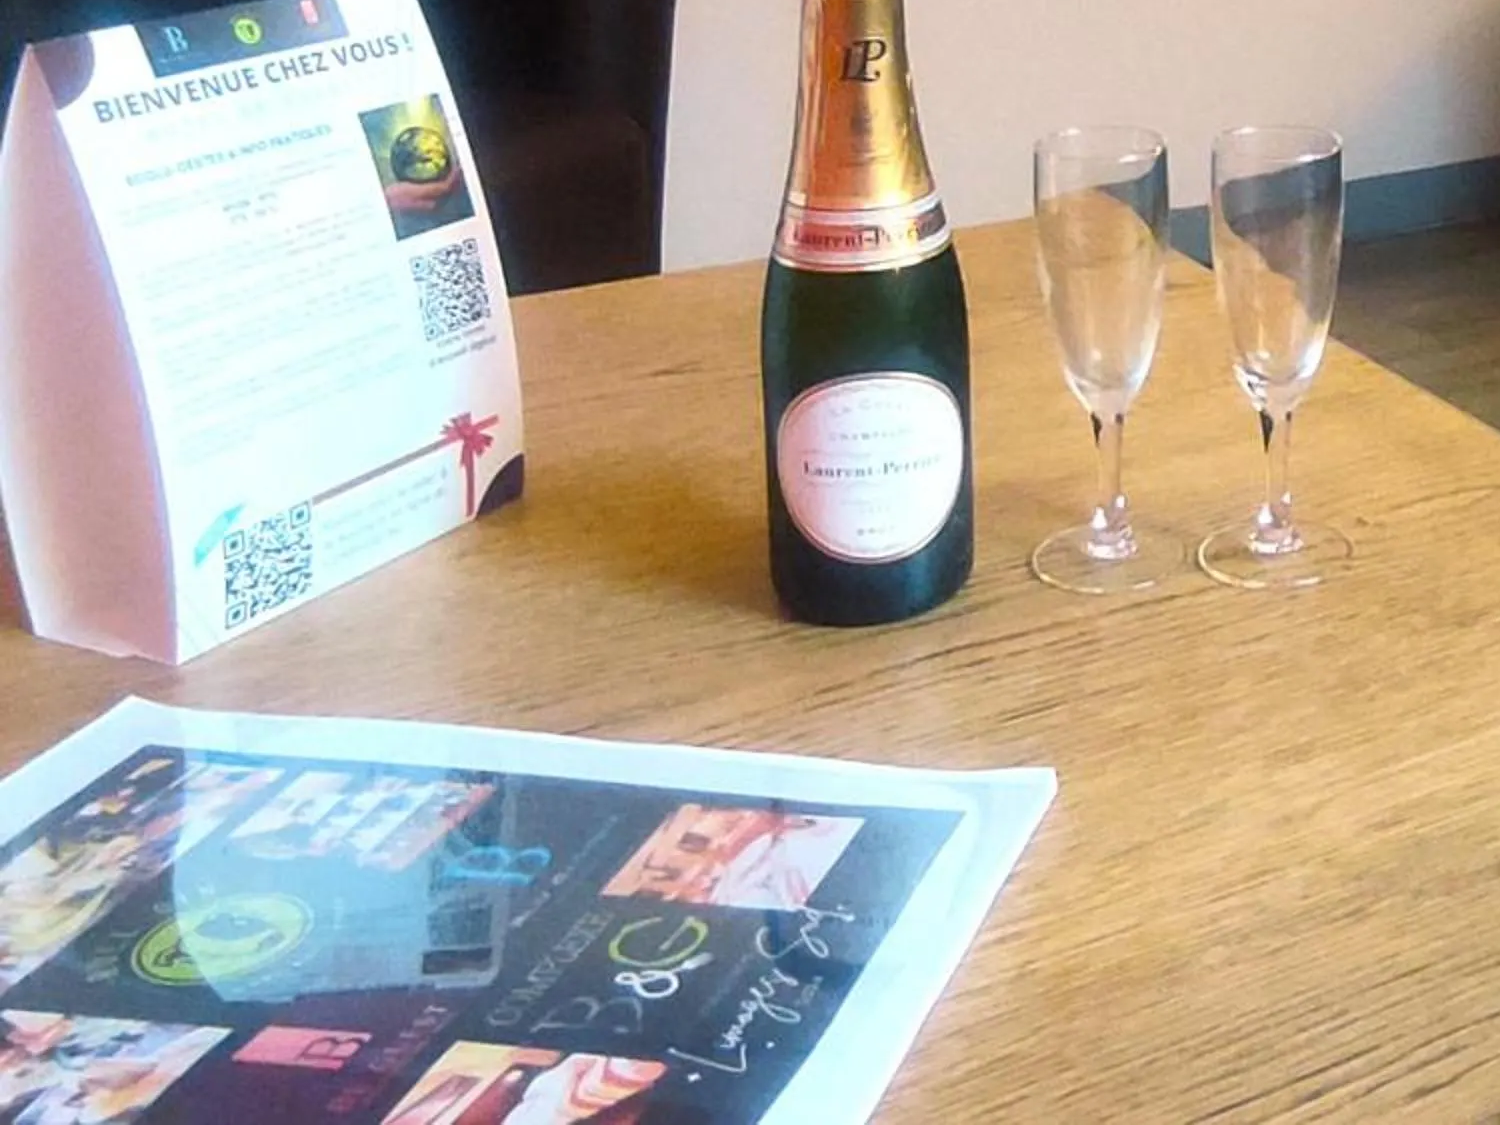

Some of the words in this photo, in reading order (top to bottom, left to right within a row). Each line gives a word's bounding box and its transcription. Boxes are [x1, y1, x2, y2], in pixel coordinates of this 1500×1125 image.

[93, 68, 259, 123] BIENVENUE
[264, 53, 329, 83] CHEZ
[331, 35, 400, 67] VOUS
